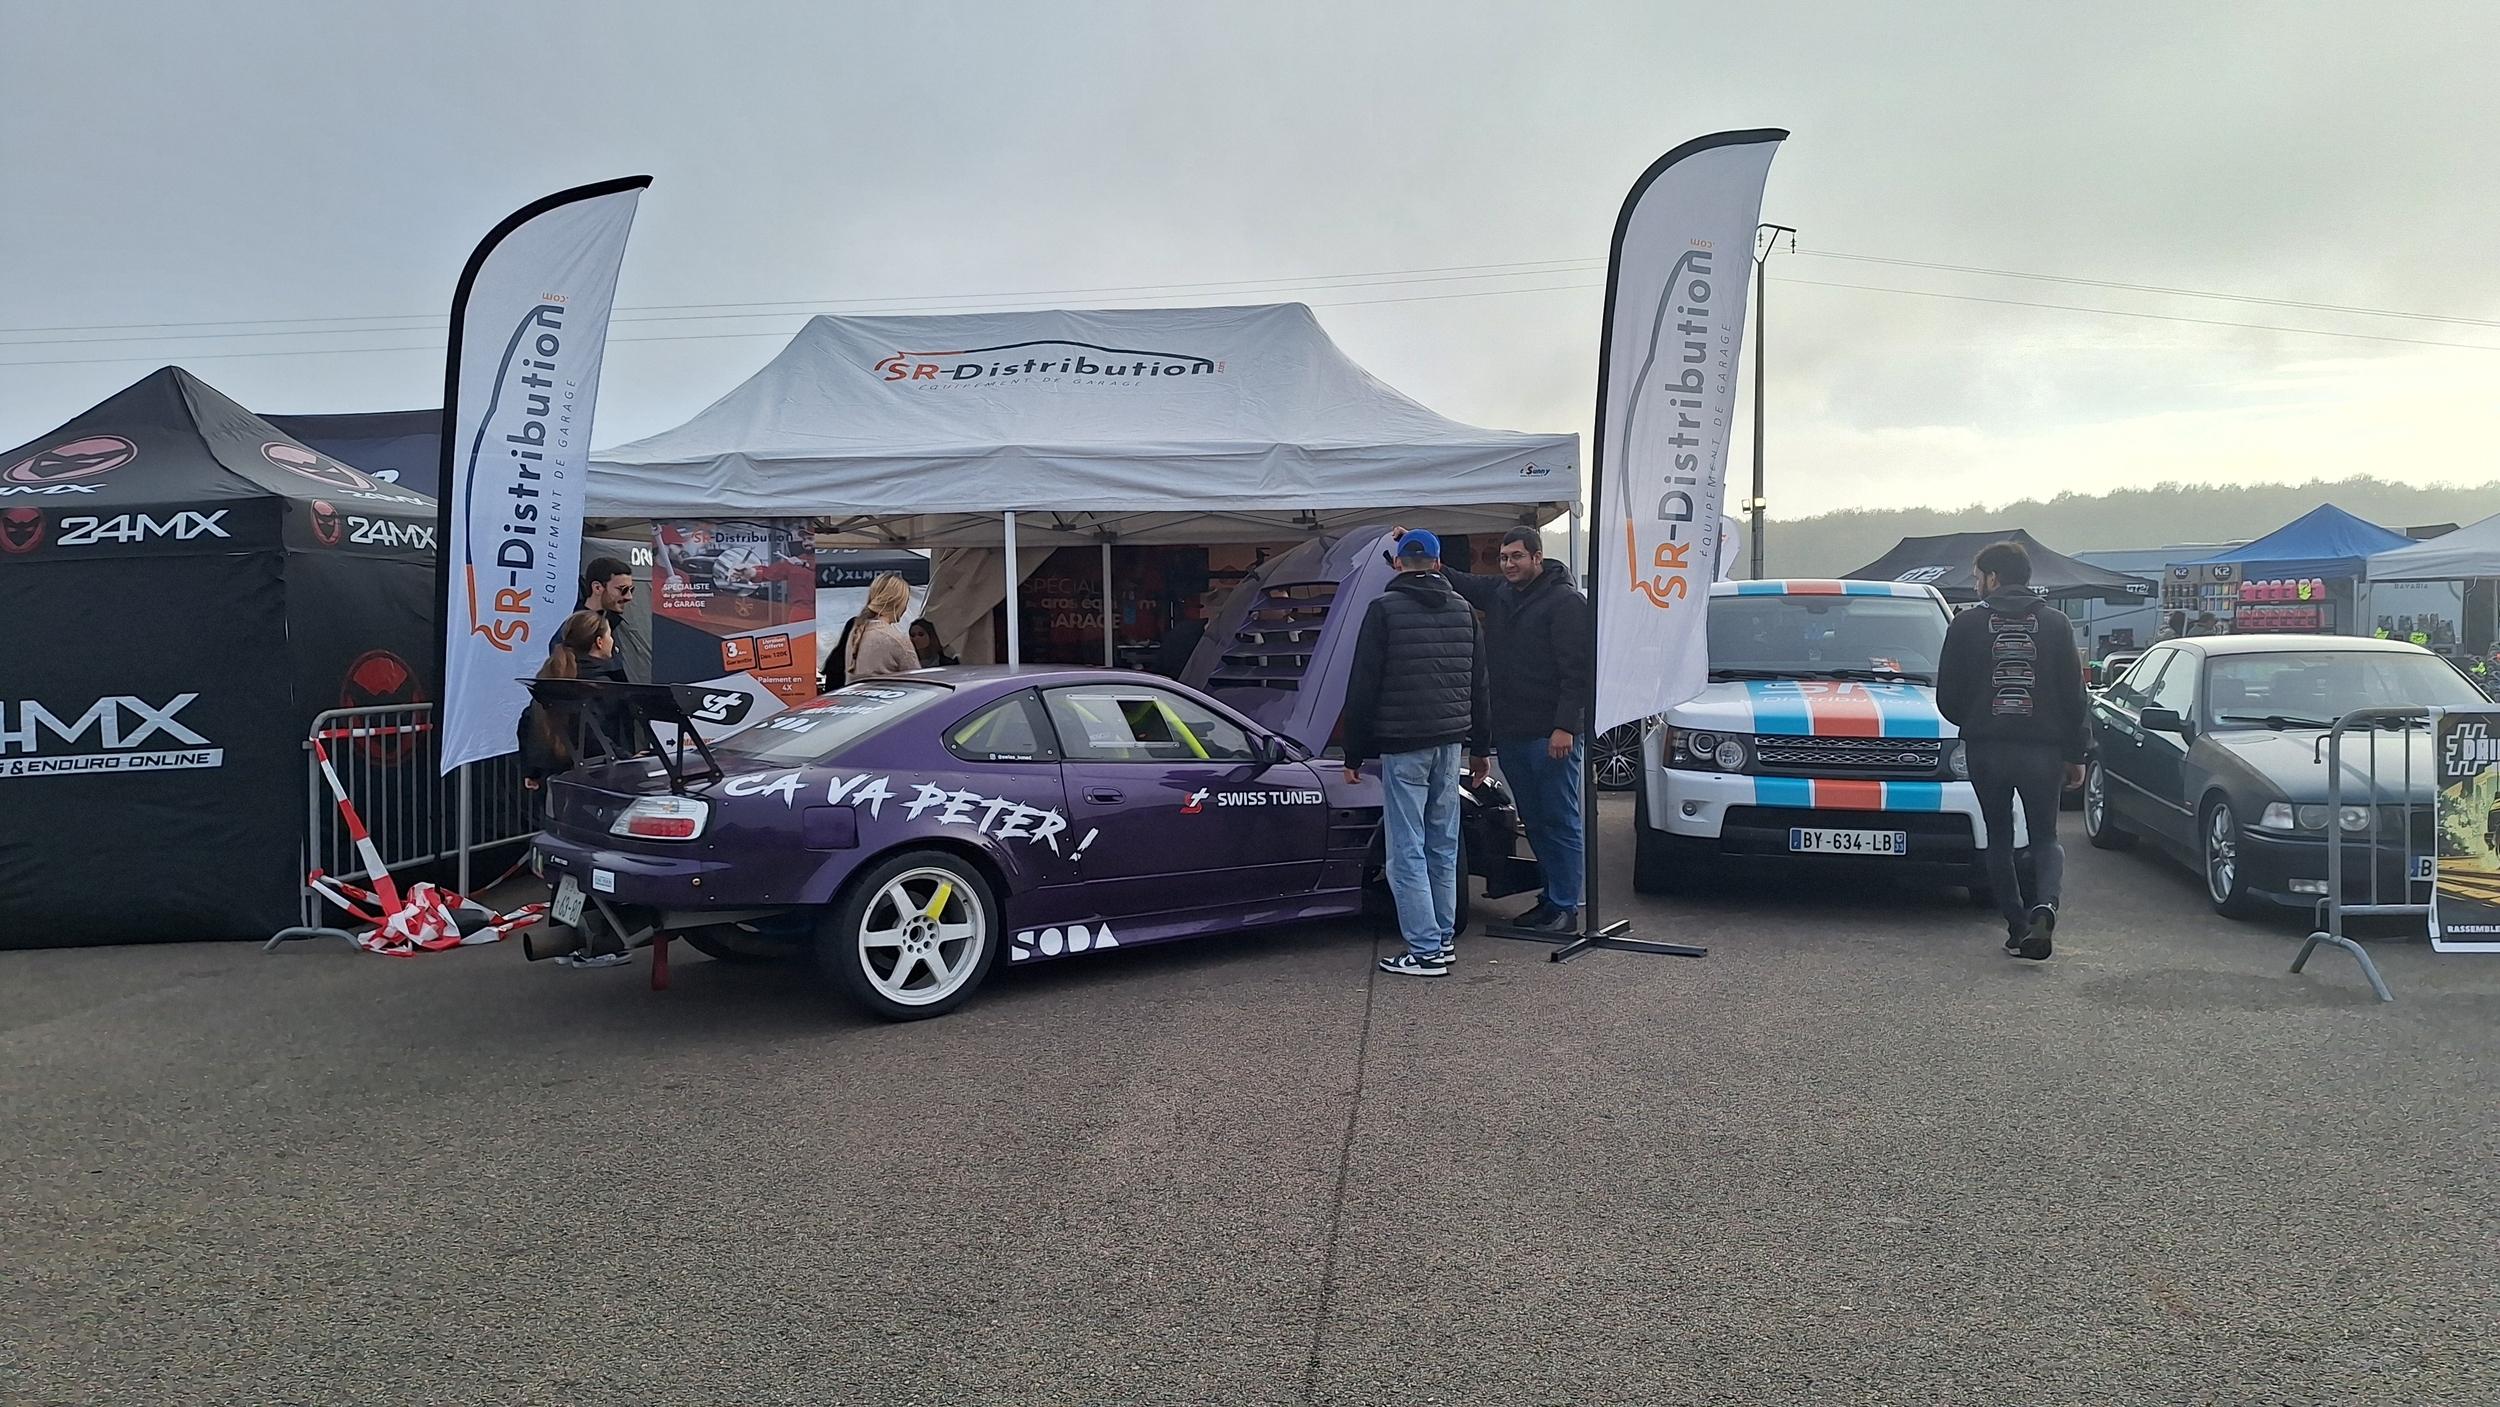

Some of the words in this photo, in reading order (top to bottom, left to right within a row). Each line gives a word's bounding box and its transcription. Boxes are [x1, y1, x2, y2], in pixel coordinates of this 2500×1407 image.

[884, 356, 1214, 381] SR-Distribution
[1718, 323, 1732, 394] GARAGE
[1072, 378, 1143, 387] GARAGE
[558, 379, 577, 448] GARAGE
[1714, 406, 1724, 426] DE
[1653, 249, 1713, 600] SR-Distribution
[493, 304, 565, 643] SR-Distribution
[554, 460, 566, 479] DE
[0, 483, 107, 496] MX
[57, 509, 231, 545] 24MX
[347, 516, 437, 550] 24MX
[2174, 567, 2188, 576] K2
[2214, 566, 2231, 576] K2
[726, 642, 738, 658] 3
[128, 753, 211, 767] ONLINE
[827, 772, 898, 822] VA
[1217, 791, 1267, 806] SWISS
[1269, 790, 1323, 806] TUNED
[1803, 831, 1892, 851] BY-634-LB
[1011, 921, 1120, 962] SODA
